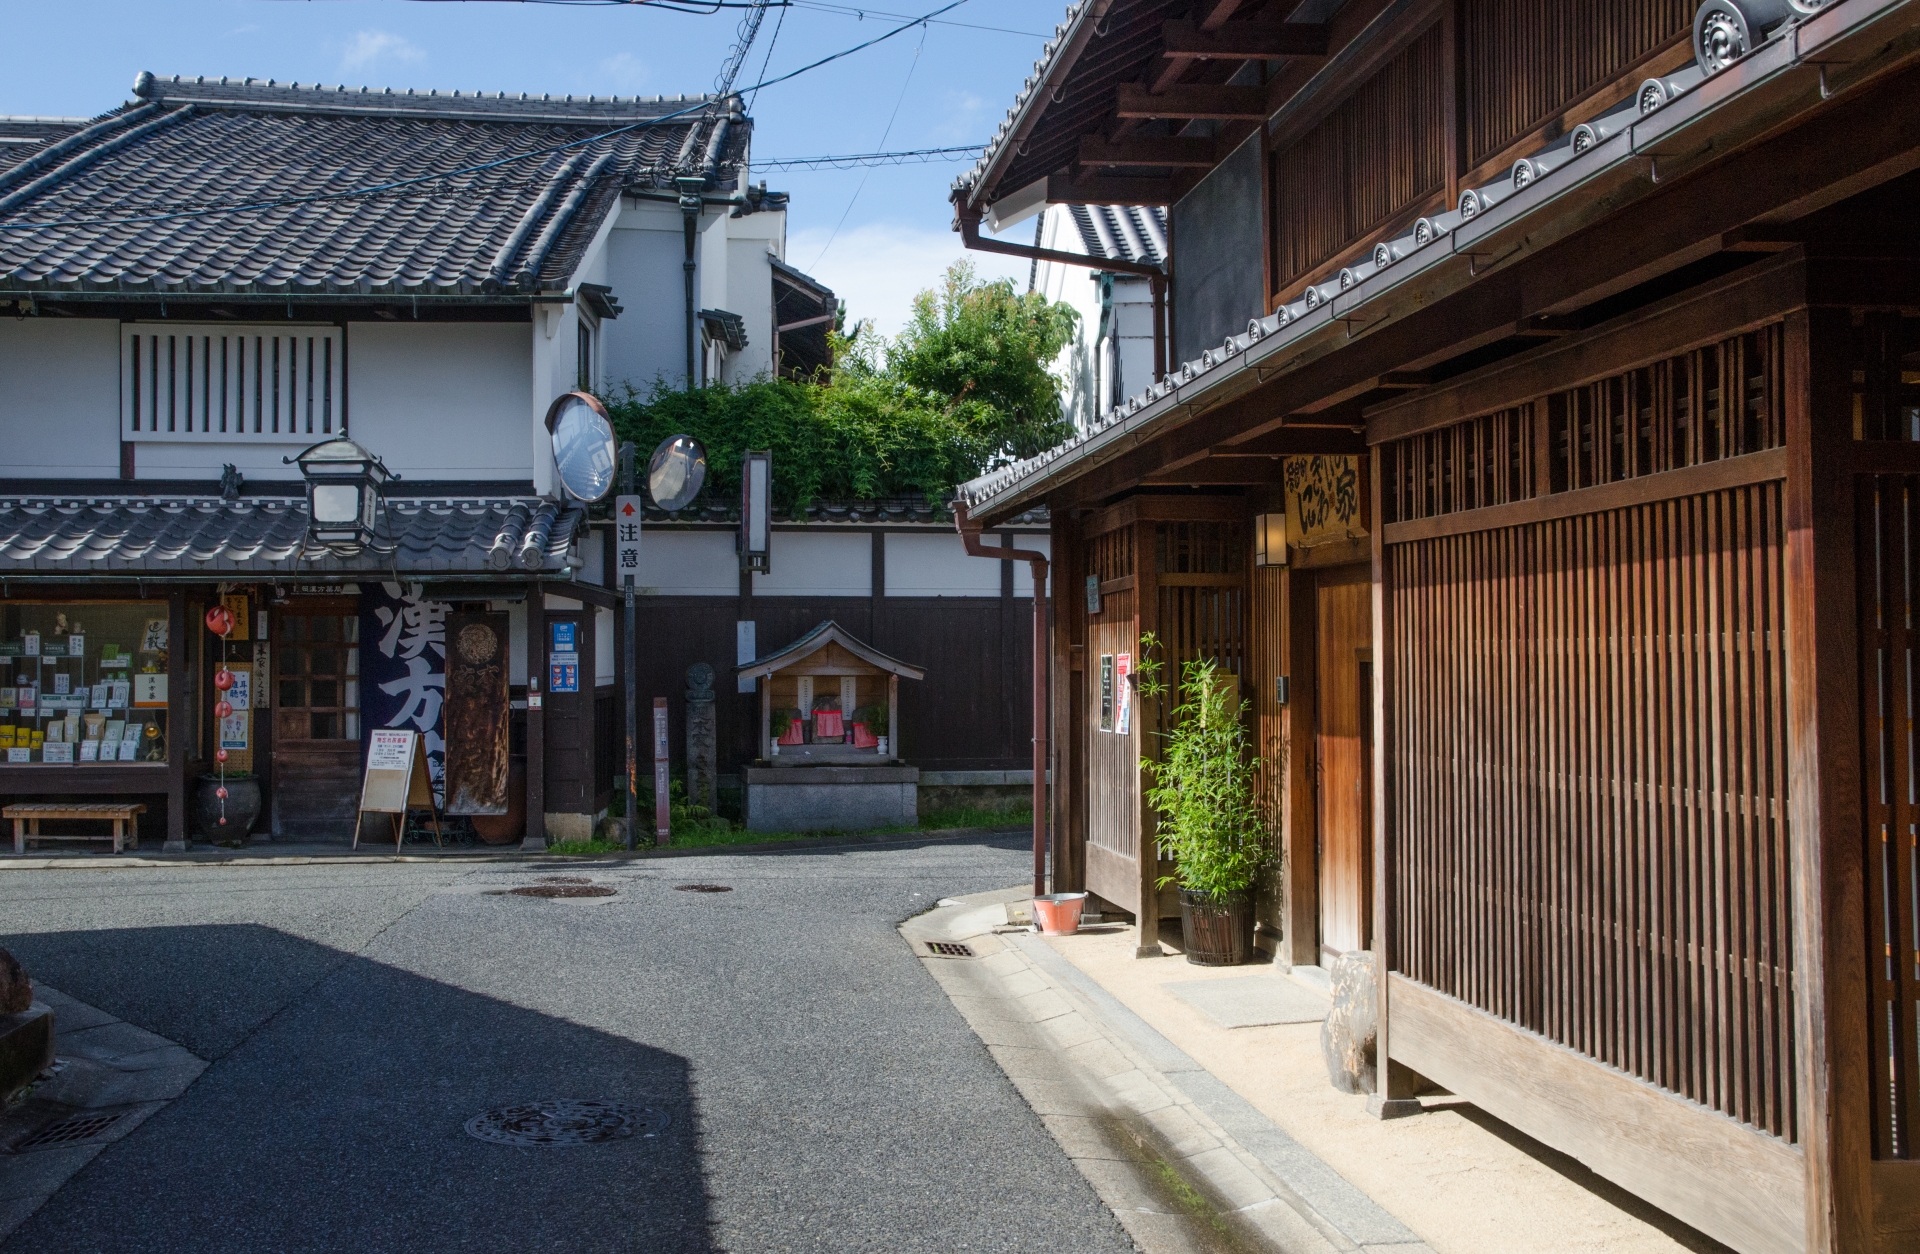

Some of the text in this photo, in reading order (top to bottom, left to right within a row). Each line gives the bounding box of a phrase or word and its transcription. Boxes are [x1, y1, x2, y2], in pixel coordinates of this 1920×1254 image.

[620, 523, 639, 568] 注意
[239, 680, 248, 707] 耳鳴り
